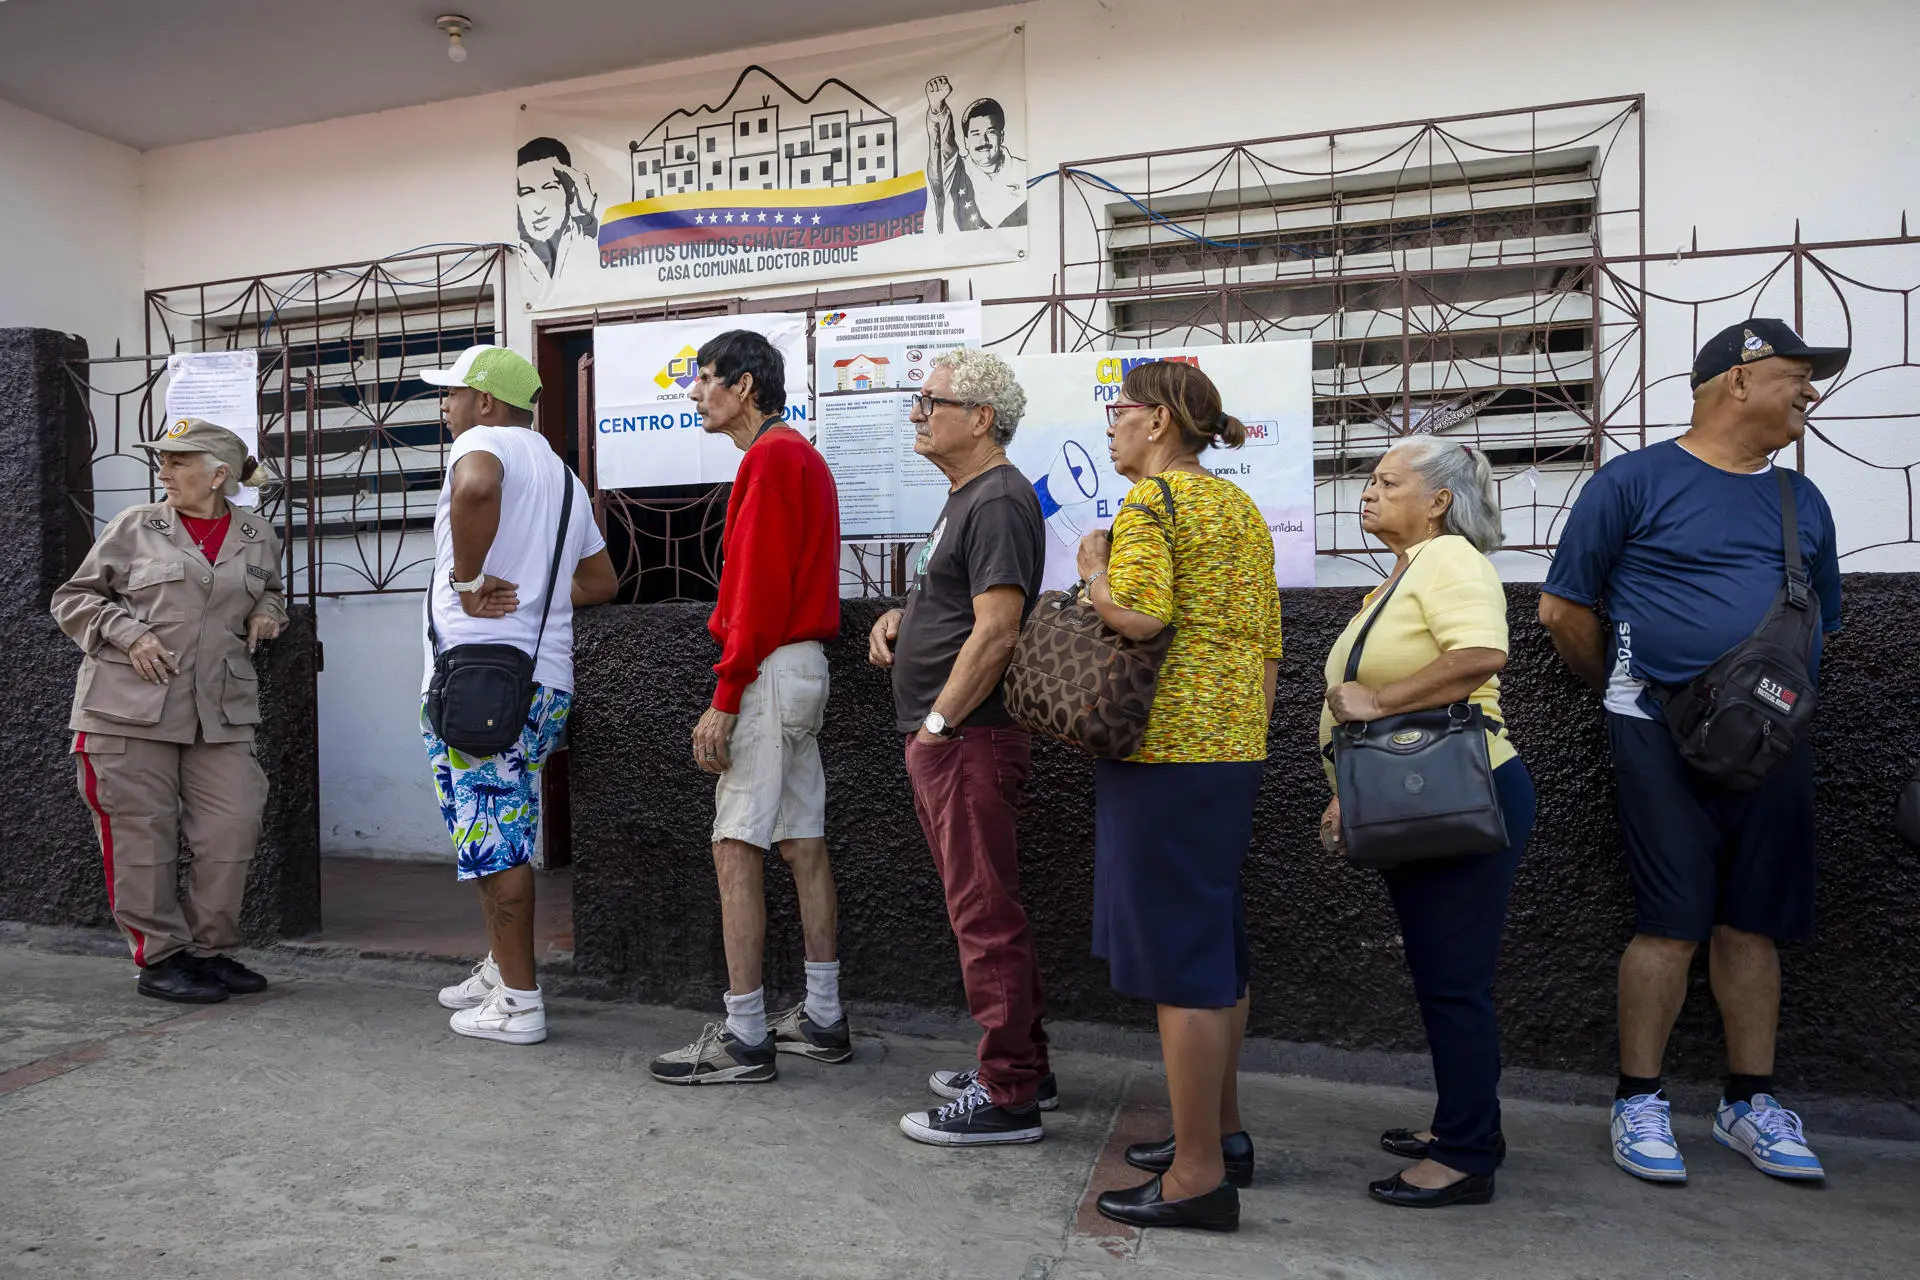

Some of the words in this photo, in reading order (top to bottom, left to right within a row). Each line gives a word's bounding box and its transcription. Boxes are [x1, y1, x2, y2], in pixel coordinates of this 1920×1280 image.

[600, 243, 676, 269] CERRITOS
[679, 235, 738, 261] UNIDOS
[742, 227, 806, 253] CHÁVEZ
[810, 225, 844, 246] POR
[848, 213, 924, 241] SIEMPRE
[658, 263, 690, 282] CASA
[693, 254, 754, 278] COMUNAL
[757, 251, 810, 272] DOCTOR
[813, 245, 858, 265] DUQUE
[905, 314, 930, 322] FUNCIONES
[938, 320, 944, 328] DE
[944, 320, 950, 328] LA
[918, 328, 936, 336] CENTRO
[656, 393, 685, 401] PODER
[599, 414, 675, 434] CENTRO
[680, 412, 703, 428] DE
[1240, 462, 1251, 475] ti
[1096, 499, 1113, 518] EL
[1268, 520, 1305, 533] unidad.
[1760, 677, 1783, 698] 5.11
